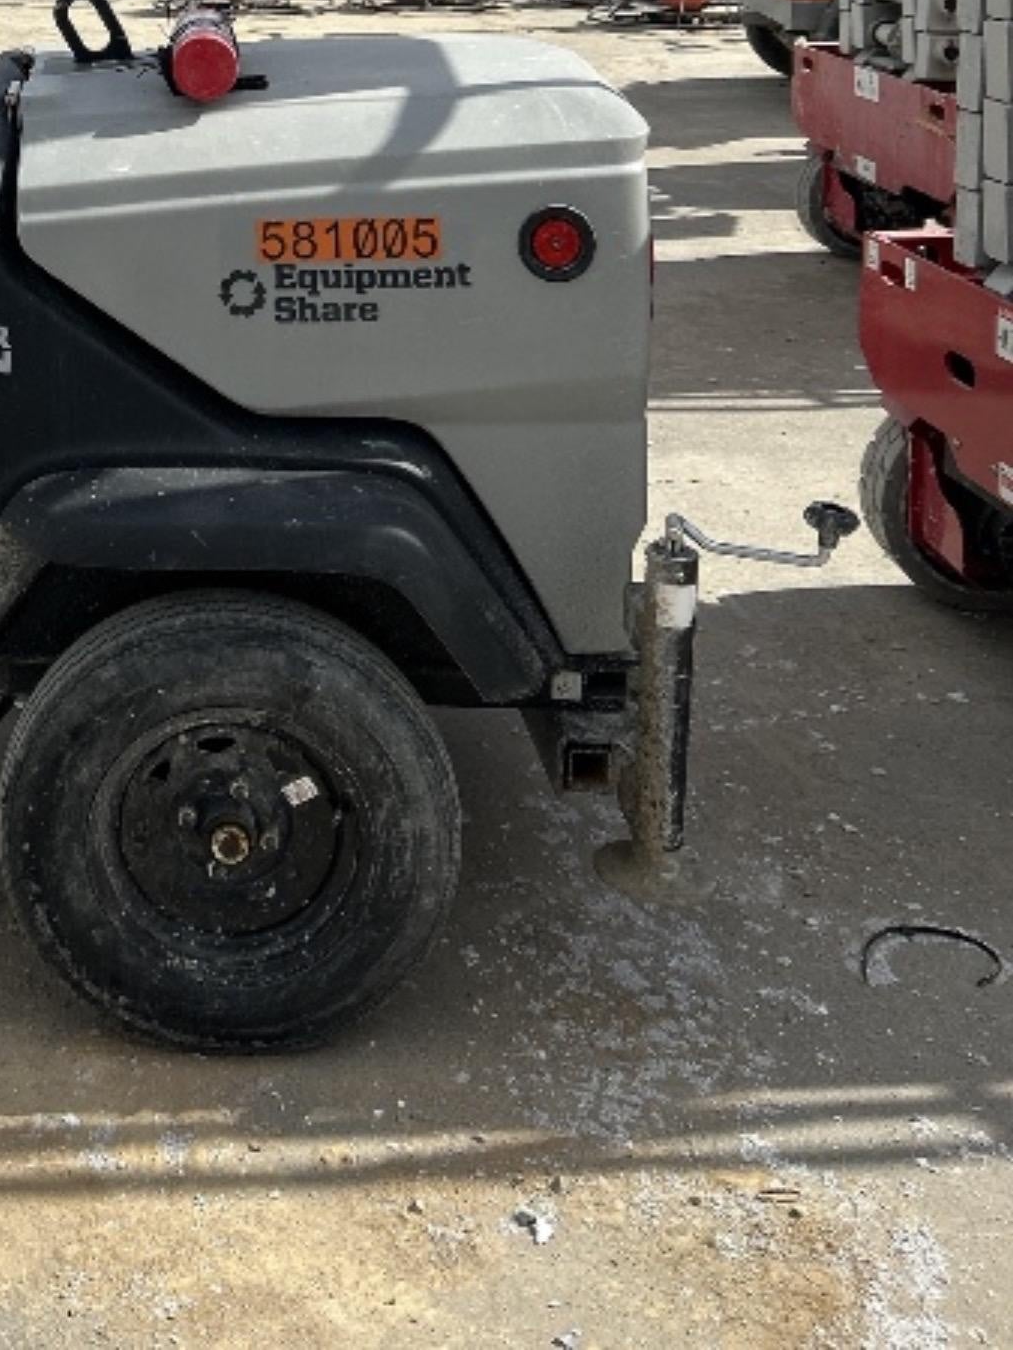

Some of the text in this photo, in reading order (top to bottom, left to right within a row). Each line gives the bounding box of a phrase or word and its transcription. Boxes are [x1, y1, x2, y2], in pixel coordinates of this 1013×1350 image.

[261, 218, 438, 261] 581005
[274, 262, 472, 296] Equipment
[274, 296, 379, 324] Share
